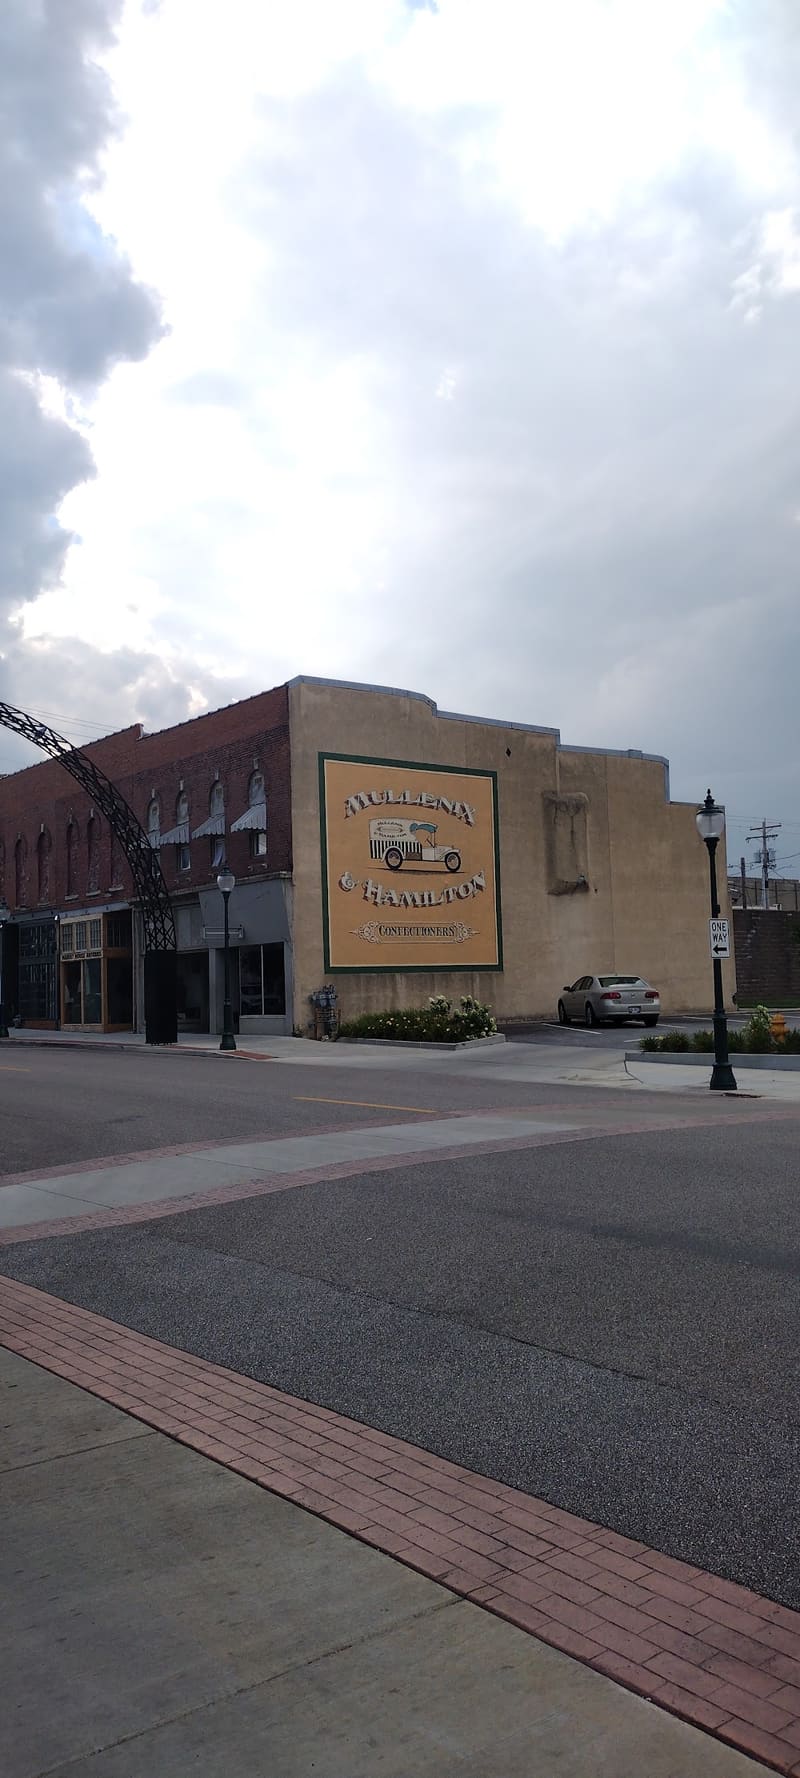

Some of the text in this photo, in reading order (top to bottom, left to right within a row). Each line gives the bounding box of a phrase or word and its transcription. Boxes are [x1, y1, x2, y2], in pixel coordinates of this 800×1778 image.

[339, 870, 487, 909] & HAMILTON
[379, 925, 455, 937] CONFECTIONERS
[711, 922, 727, 932] ONE
[712, 933, 727, 943] WAY
